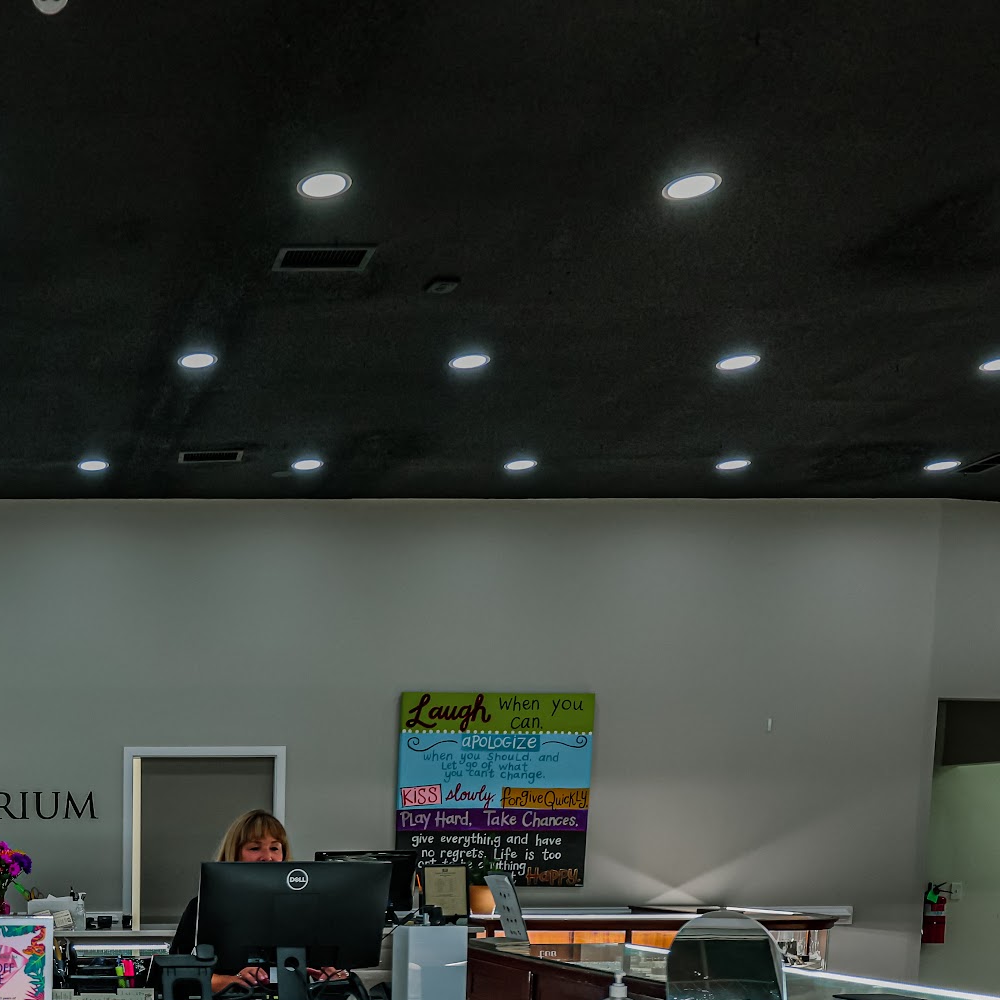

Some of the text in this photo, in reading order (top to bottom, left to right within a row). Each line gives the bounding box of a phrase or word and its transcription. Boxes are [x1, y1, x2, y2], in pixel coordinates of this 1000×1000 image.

[406, 693, 584, 732] Laugh When you
[423, 750, 453, 762] when
[460, 752, 480, 765] you
[539, 752, 560, 762] and
[441, 761, 529, 772] Let go of what
[444, 769, 464, 783] you
[501, 770, 546, 784] change.
[483, 810, 517, 826] Take
[522, 811, 579, 828] Chances.
[411, 832, 562, 848] give everything and have
[421, 848, 435, 858] no
[440, 847, 486, 862] regrets.
[493, 847, 518, 861] Life
[525, 848, 535, 860] is
[542, 848, 562, 860] too
